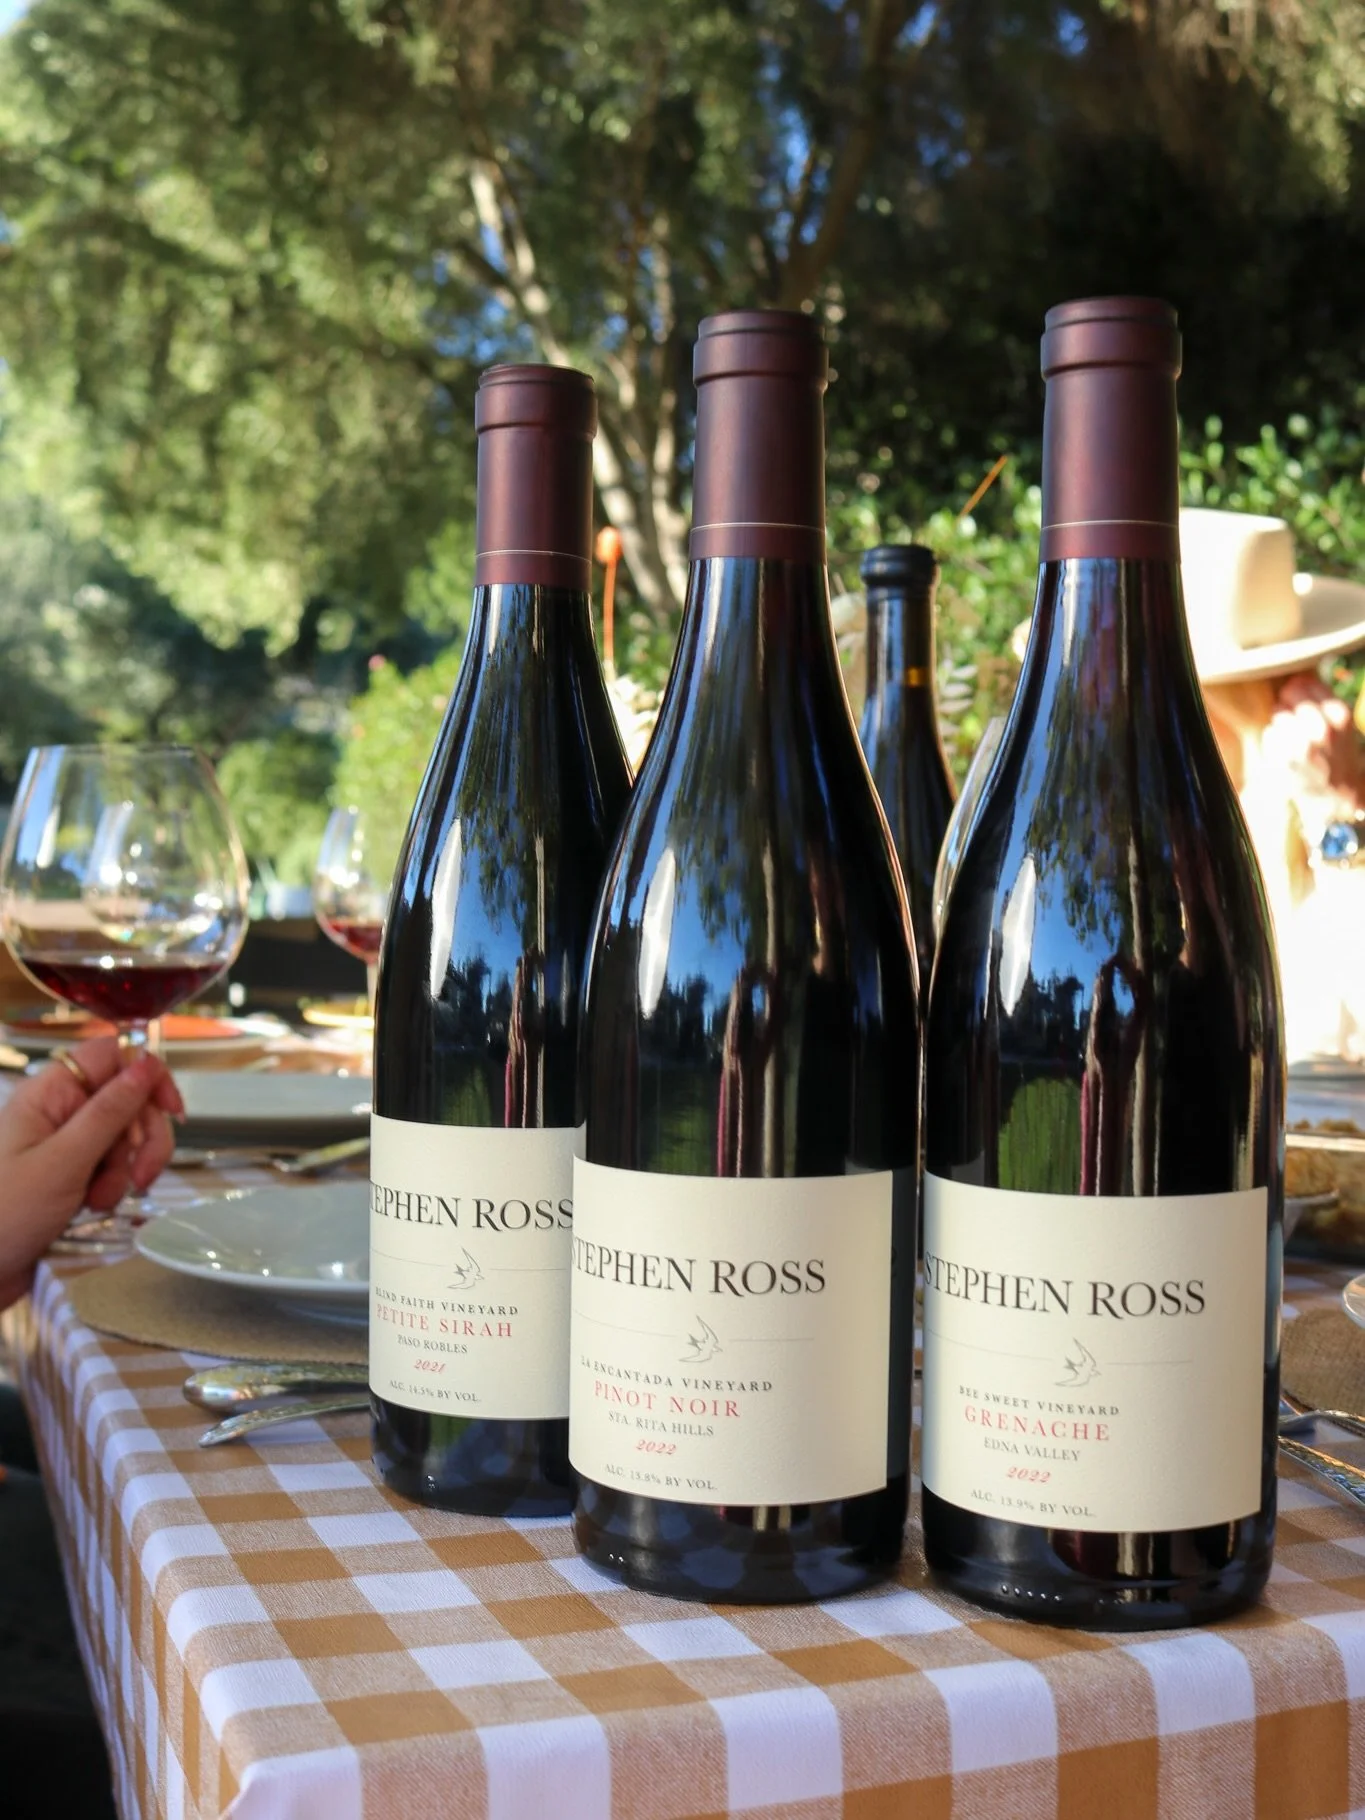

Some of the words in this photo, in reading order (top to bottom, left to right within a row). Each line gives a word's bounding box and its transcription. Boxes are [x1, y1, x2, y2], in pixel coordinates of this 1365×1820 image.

[370, 1180, 461, 1227] TEPHEN
[471, 1198, 572, 1231] ROSS
[708, 1259, 825, 1297] ROSS
[925, 1251, 1073, 1314] STEPHEN
[1087, 1280, 1205, 1320] ROSS
[375, 1286, 397, 1302] BLIND
[400, 1295, 434, 1311] FAITH
[441, 1302, 519, 1315] VINEYARD
[376, 1303, 429, 1330] PETITE
[439, 1318, 513, 1337] SIRAH
[397, 1334, 421, 1349] PASO
[423, 1340, 468, 1354] ROBLES
[413, 1358, 446, 1373] 2021
[593, 1360, 673, 1387] ENCANTADA
[681, 1376, 773, 1392] VINEYARD
[437, 1388, 451, 1399] BY
[455, 1391, 482, 1402] VOL.
[594, 1380, 657, 1410] PINOT
[669, 1396, 741, 1418] NOIR
[959, 1385, 979, 1400] BEE
[984, 1391, 1030, 1409] SWEET
[1037, 1401, 1120, 1416] VINEYARD
[635, 1416, 667, 1433] RITA
[671, 1422, 714, 1437] HILLS
[964, 1404, 1110, 1441] GRENACHE
[635, 1438, 677, 1455] 2022
[984, 1436, 1019, 1455] EDNA
[1024, 1444, 1081, 1462] VALLEY
[630, 1470, 661, 1485] 13.8%
[665, 1475, 682, 1488] BY
[686, 1478, 718, 1491] VOL.
[1006, 1466, 1052, 1484] 2022
[1001, 1495, 1035, 1511] 13.9%
[1039, 1502, 1057, 1514] BY
[1063, 1505, 1097, 1518] VOL.
